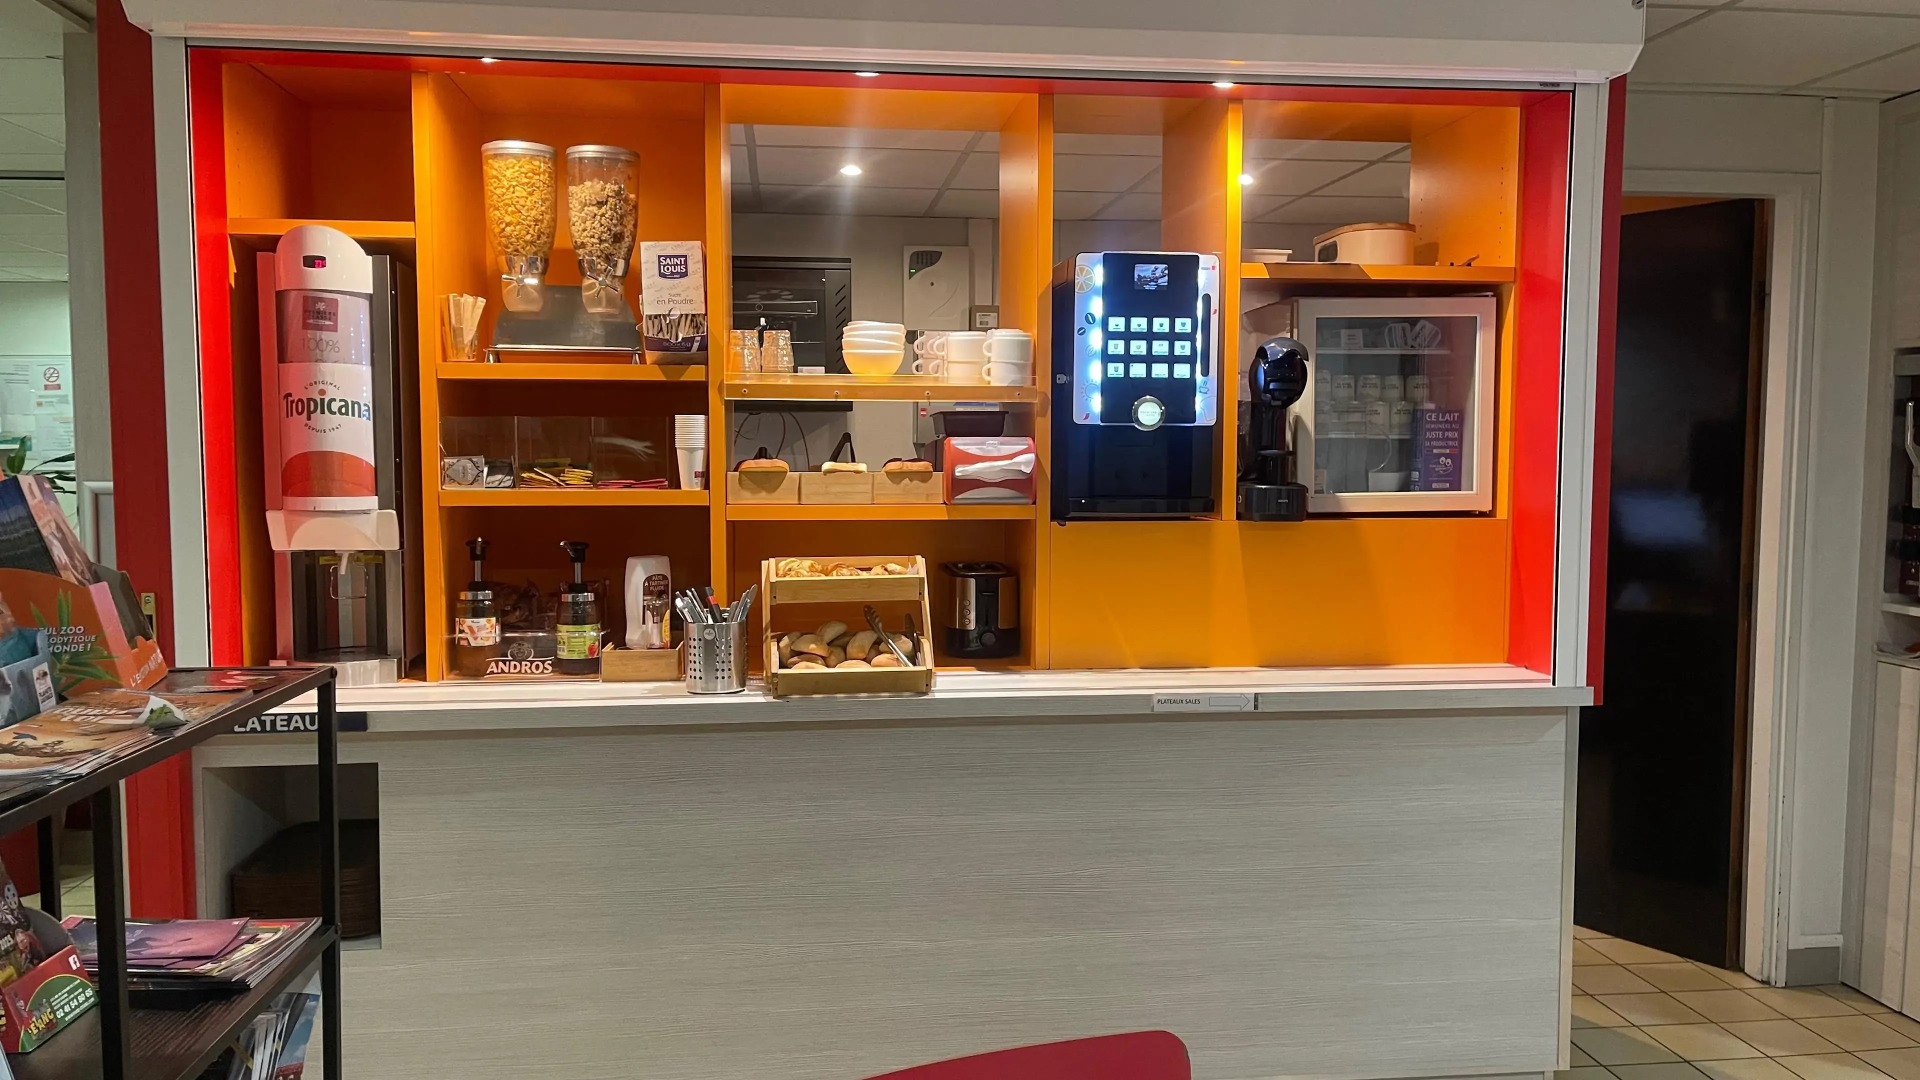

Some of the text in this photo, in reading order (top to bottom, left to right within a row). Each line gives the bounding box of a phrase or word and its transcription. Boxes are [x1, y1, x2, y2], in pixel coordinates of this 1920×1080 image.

[660, 256, 686, 265] SAINT
[660, 265, 686, 275] LOUIS
[283, 389, 371, 421] Tropicana
[1426, 413, 1459, 421] CE LAIT
[1425, 431, 1459, 439] JUSTE PRIX
[60, 626, 85, 635] ZOO
[48, 635, 97, 644] ODYTIQUE
[486, 660, 553, 675] ANDROS
[233, 714, 318, 732] LATEAU
